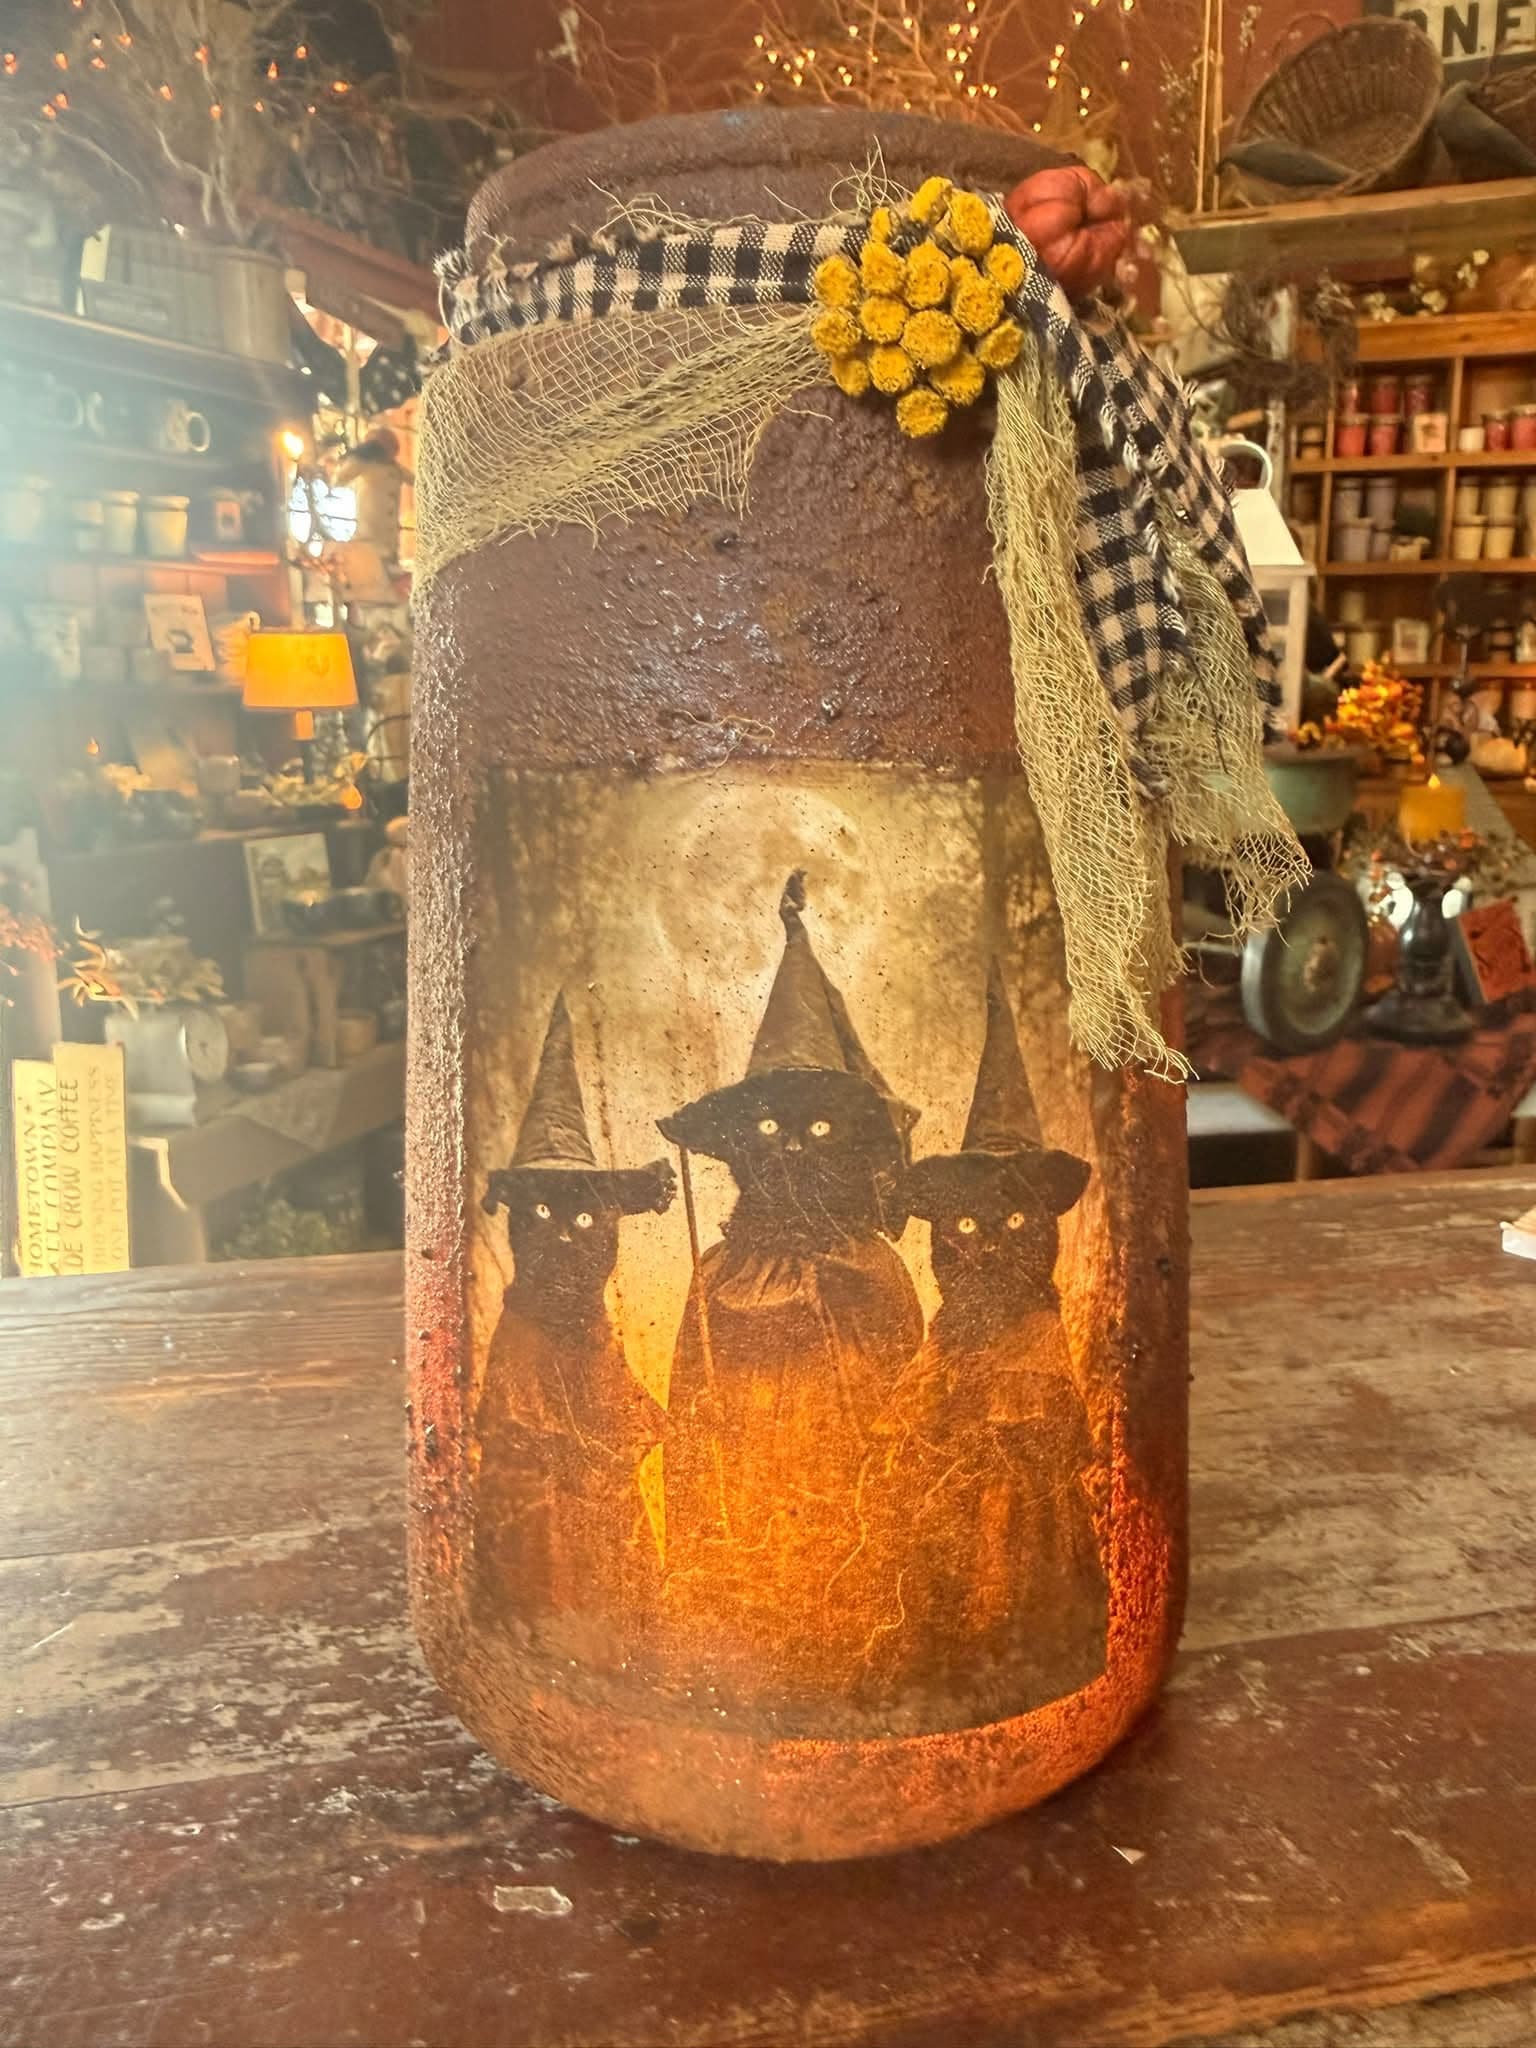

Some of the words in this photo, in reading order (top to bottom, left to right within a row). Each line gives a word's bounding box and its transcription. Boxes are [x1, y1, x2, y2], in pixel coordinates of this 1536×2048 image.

[58, 1079, 79, 1152] COFFEE
[62, 1166, 82, 1228] CROW
[62, 1243, 83, 1274] DE
